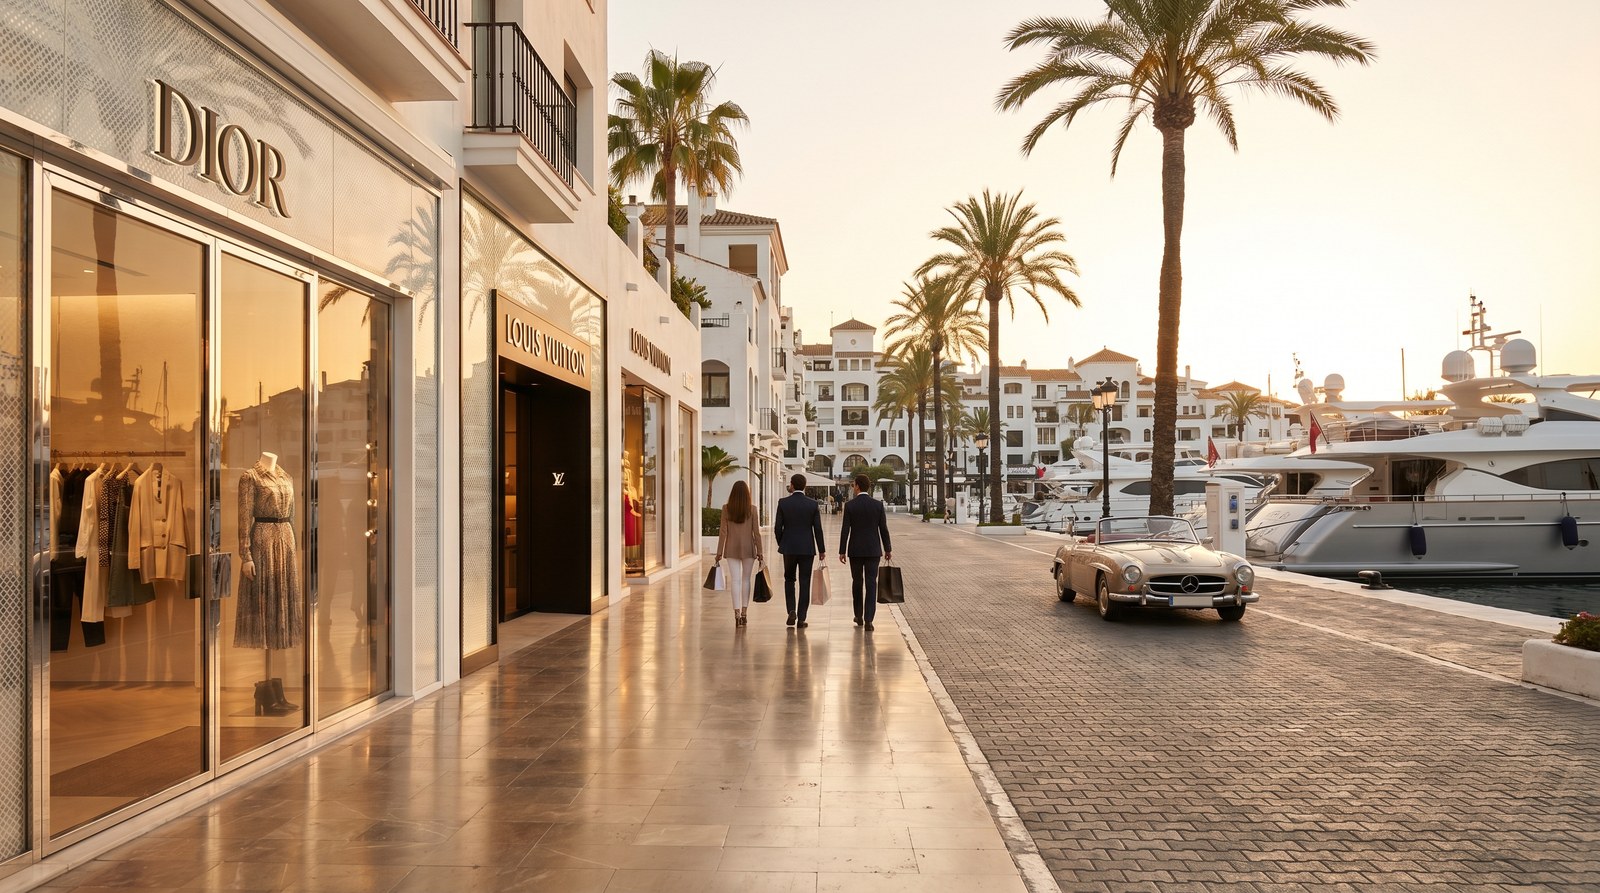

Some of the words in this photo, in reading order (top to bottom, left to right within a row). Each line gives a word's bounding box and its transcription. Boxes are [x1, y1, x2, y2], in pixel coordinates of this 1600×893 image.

[151, 79, 291, 218] DIOR
[505, 314, 541, 357] LOUIS
[543, 333, 586, 377] VUITTON
[630, 328, 649, 360] LOUIS
